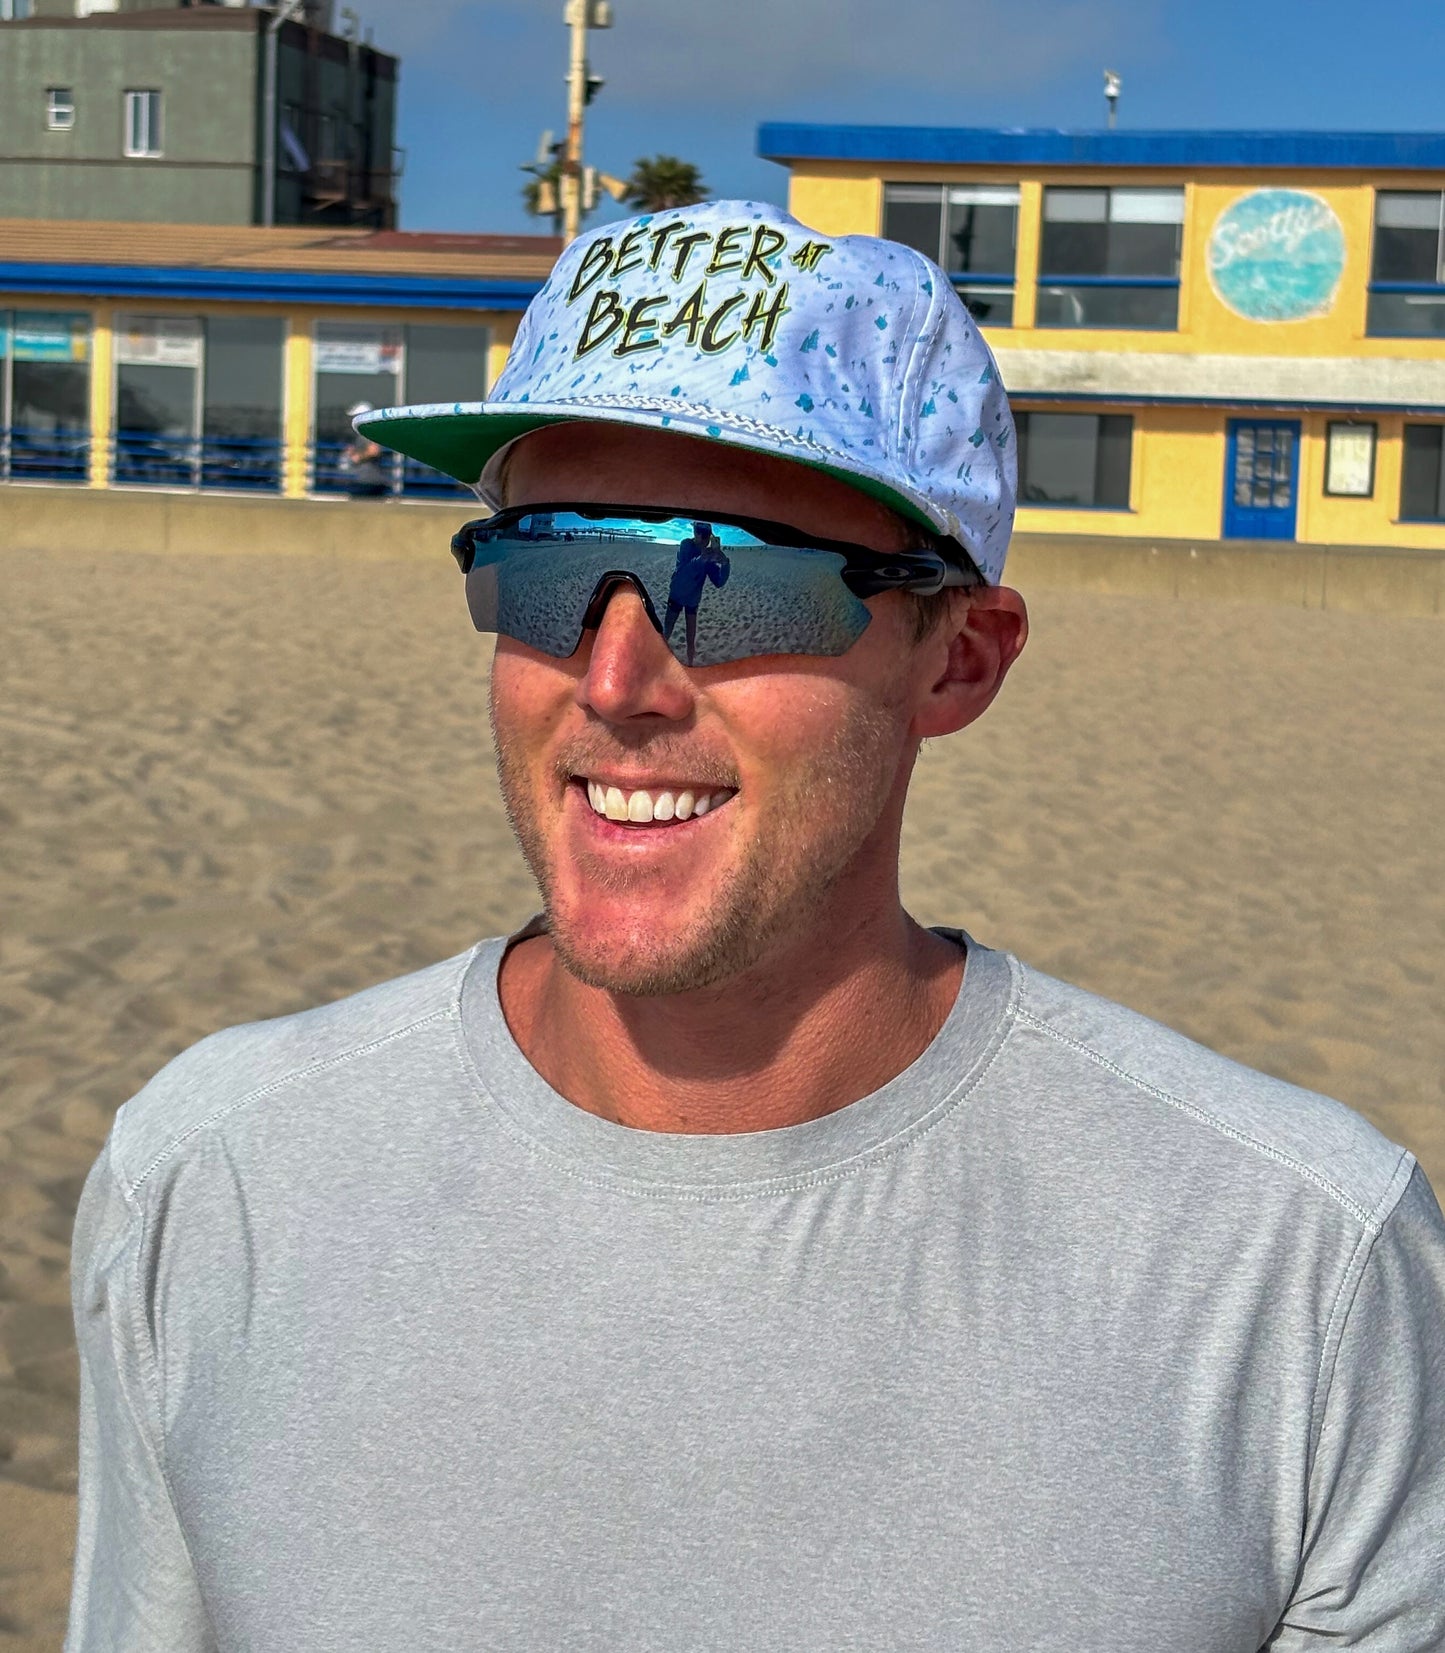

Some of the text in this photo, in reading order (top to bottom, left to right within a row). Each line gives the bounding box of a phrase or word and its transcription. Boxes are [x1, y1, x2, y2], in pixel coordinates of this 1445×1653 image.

[566, 221, 833, 307] BETTER AT
[573, 279, 792, 363] BEACH
